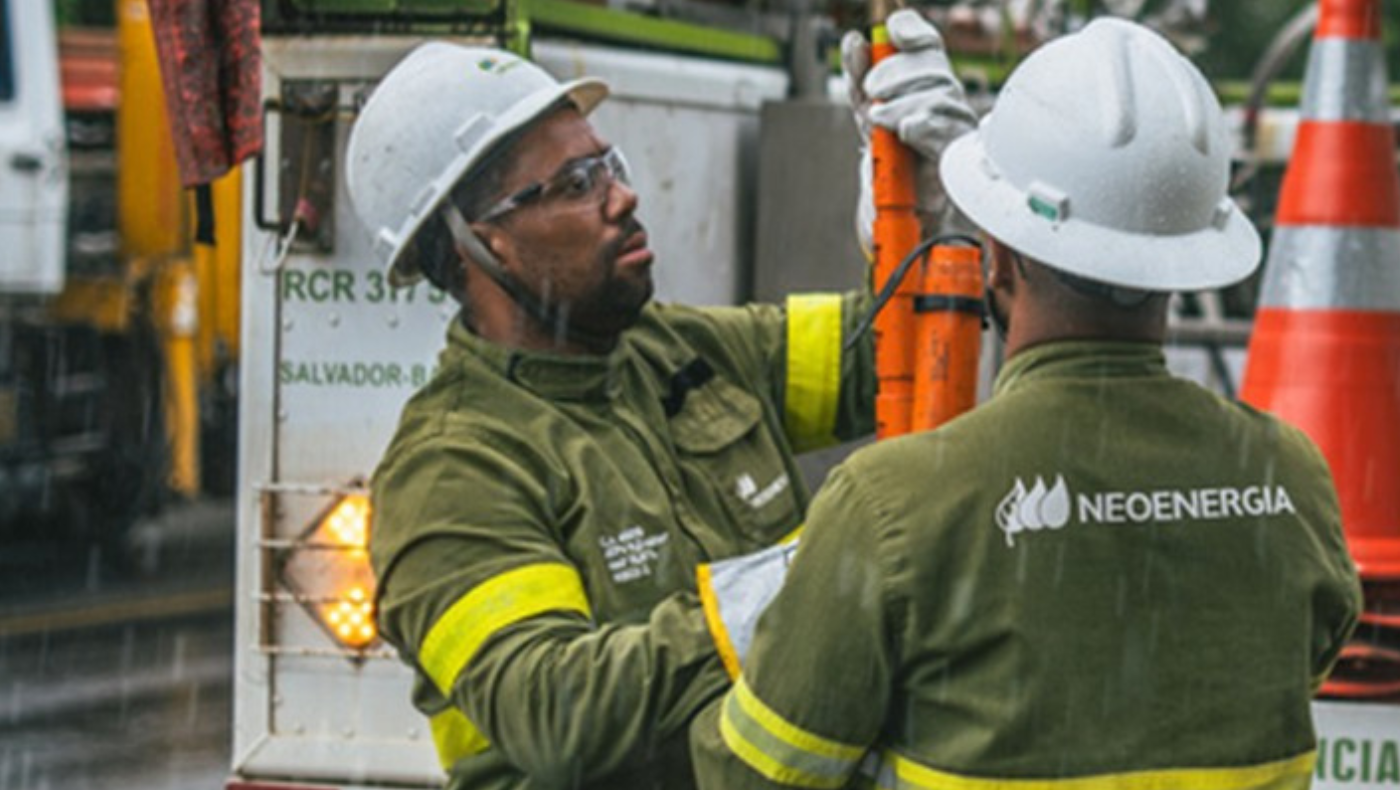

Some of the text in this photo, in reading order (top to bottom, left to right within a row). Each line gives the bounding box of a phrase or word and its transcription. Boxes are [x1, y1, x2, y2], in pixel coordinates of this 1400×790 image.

[283, 269, 354, 302] RCR
[280, 362, 438, 387] SALVADOR-B
[1077, 485, 1295, 523] NEOENERGIA
